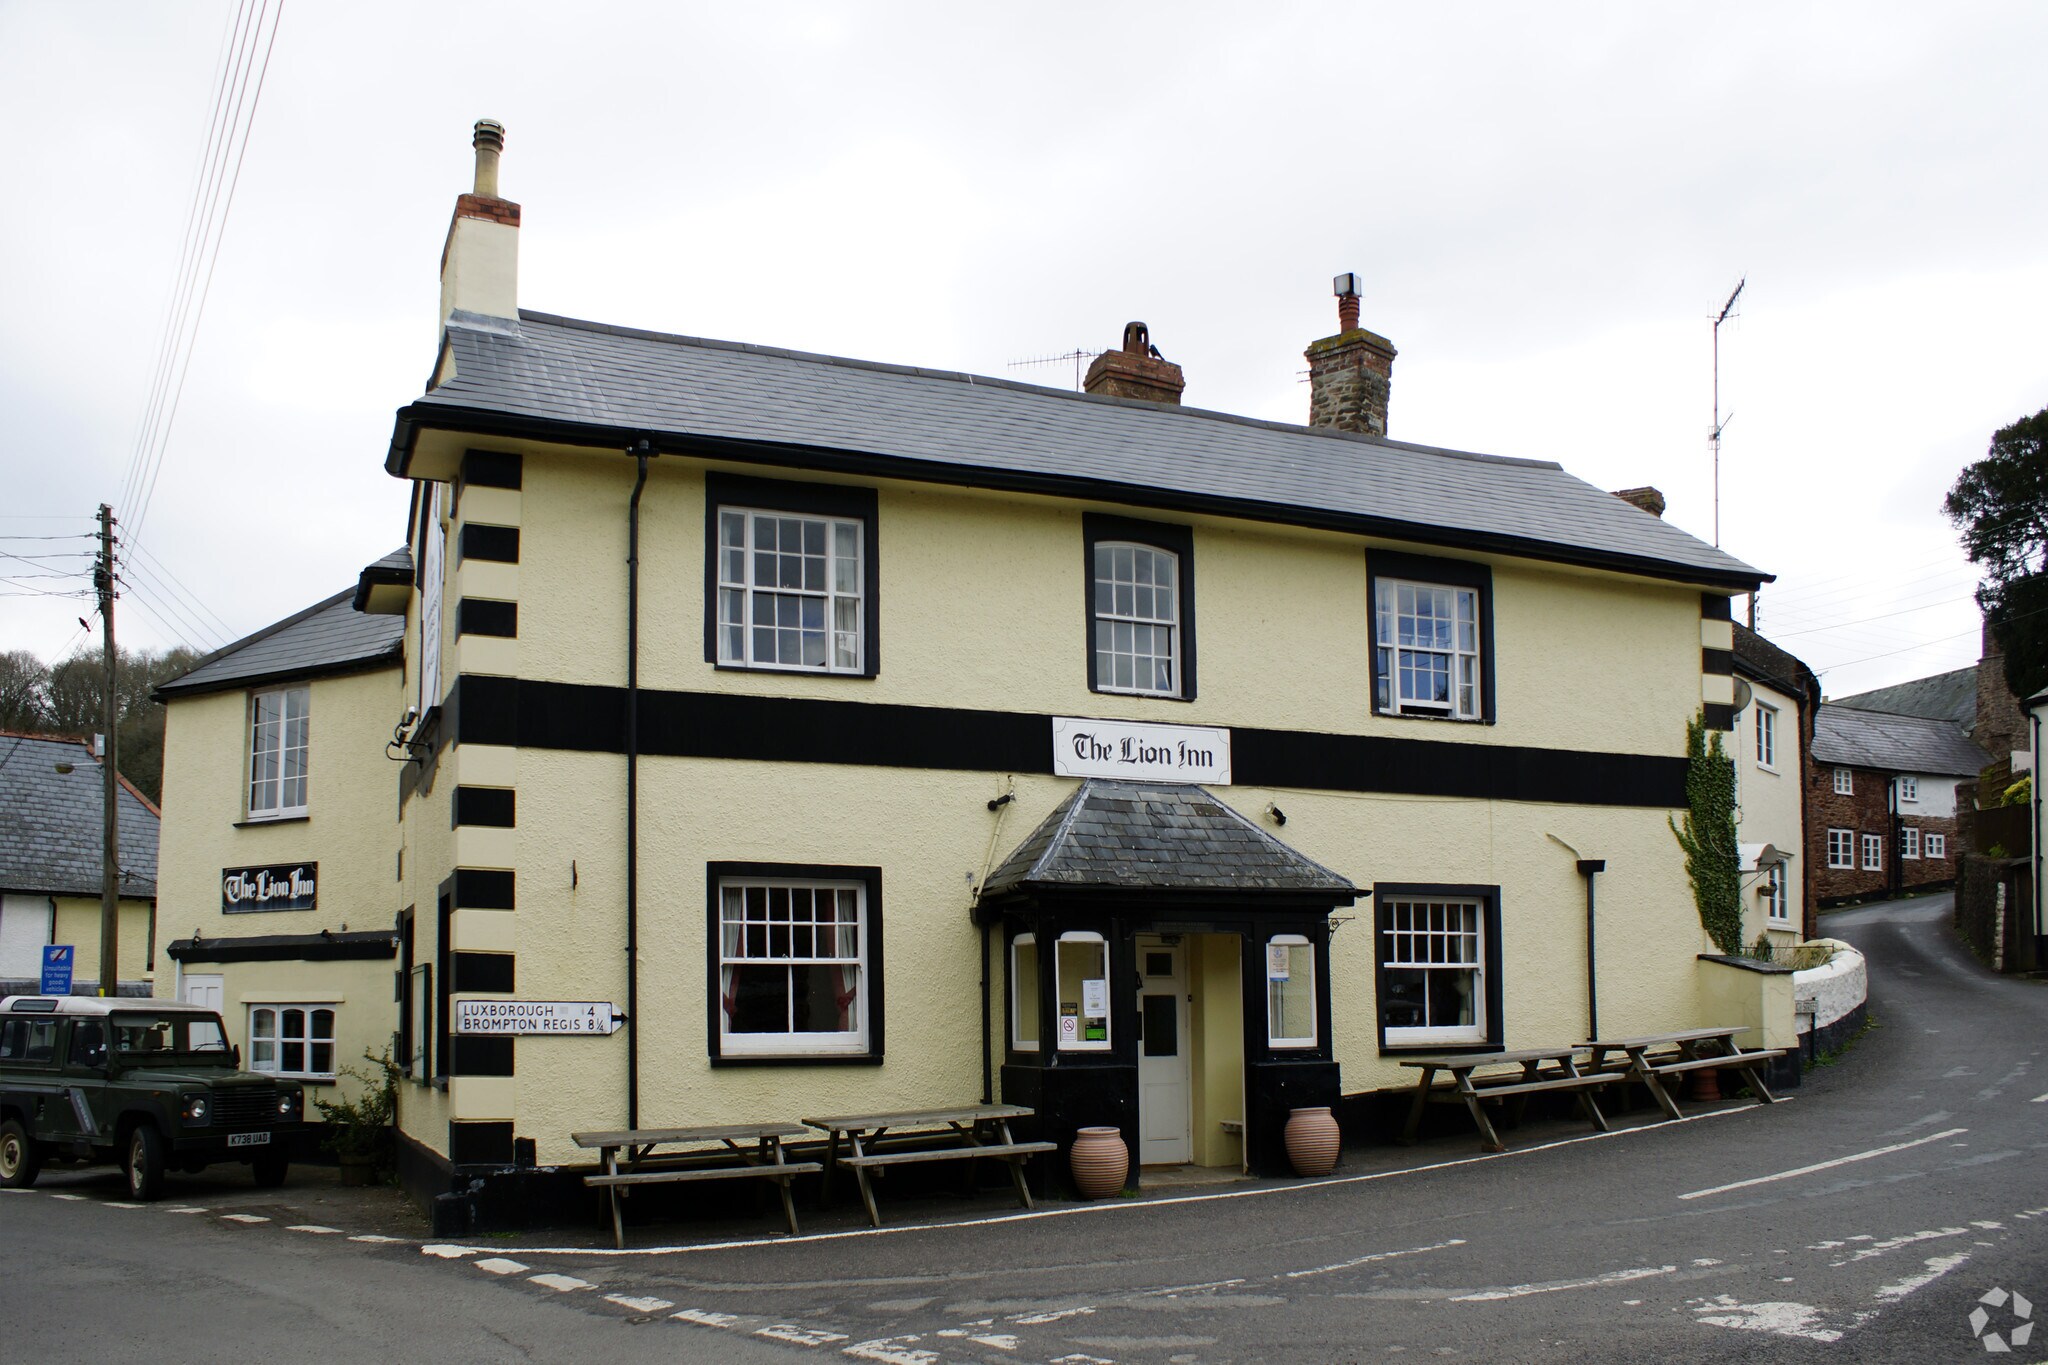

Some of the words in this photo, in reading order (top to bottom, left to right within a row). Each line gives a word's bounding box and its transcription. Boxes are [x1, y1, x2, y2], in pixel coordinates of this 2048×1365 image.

[1072, 733, 1113, 763] The
[1117, 736, 1172, 765] Lion
[1177, 740, 1214, 769] Inn
[224, 871, 257, 903] The
[256, 869, 290, 902] Lion
[289, 867, 315, 899] Inn
[463, 1005, 554, 1017] LUXBOROUGH
[587, 1006, 595, 1017] 4
[464, 1018, 537, 1030] BROMPTON
[544, 1019, 581, 1031] REGIS
[231, 1135, 252, 1145] K738
[253, 1133, 268, 1143] UAD
